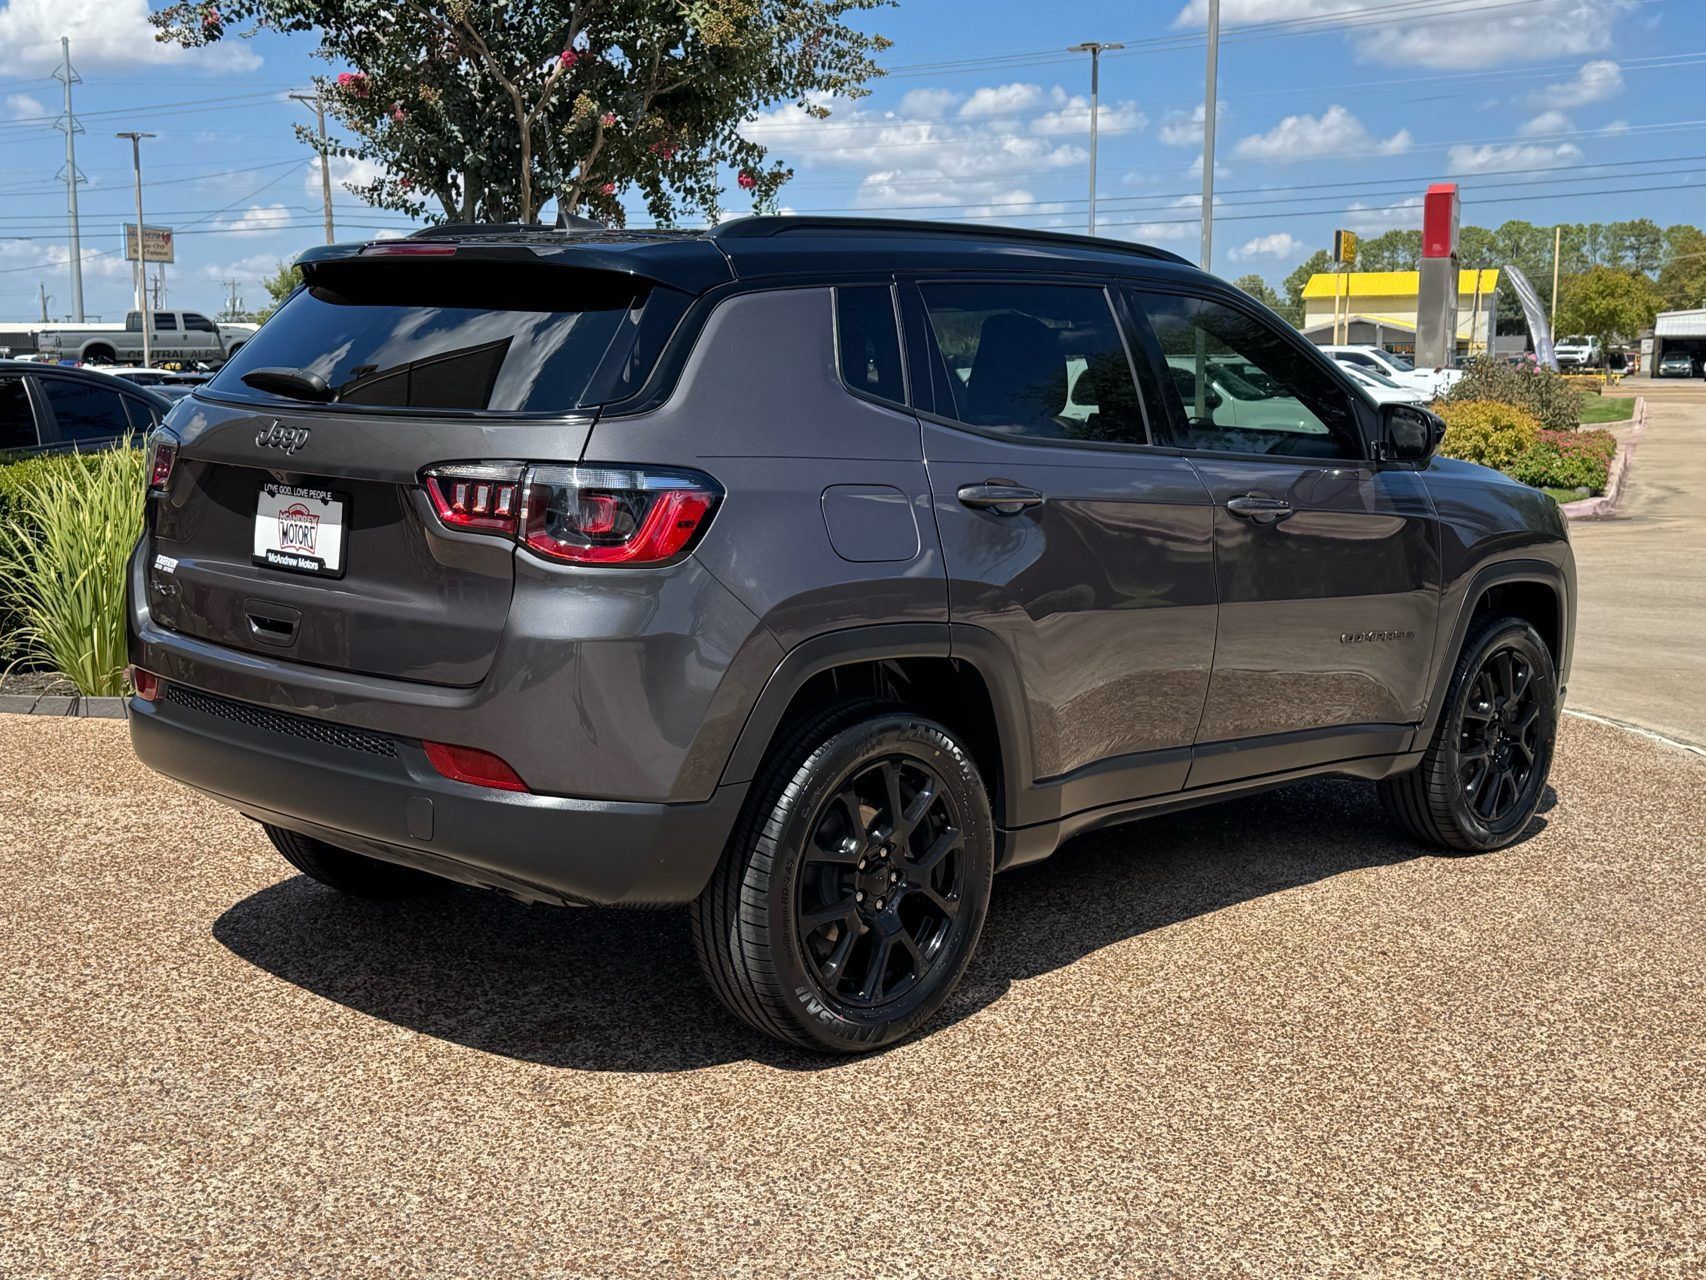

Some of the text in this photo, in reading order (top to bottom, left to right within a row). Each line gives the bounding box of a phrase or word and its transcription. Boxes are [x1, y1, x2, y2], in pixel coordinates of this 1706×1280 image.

[190, 349, 220, 359] ALPS
[255, 419, 311, 456] Jeep
[264, 483, 279, 493] LOVE
[293, 488, 309, 498] LOVE
[280, 521, 316, 550] MOTORS
[267, 552, 319, 570] McAndrew Motors
